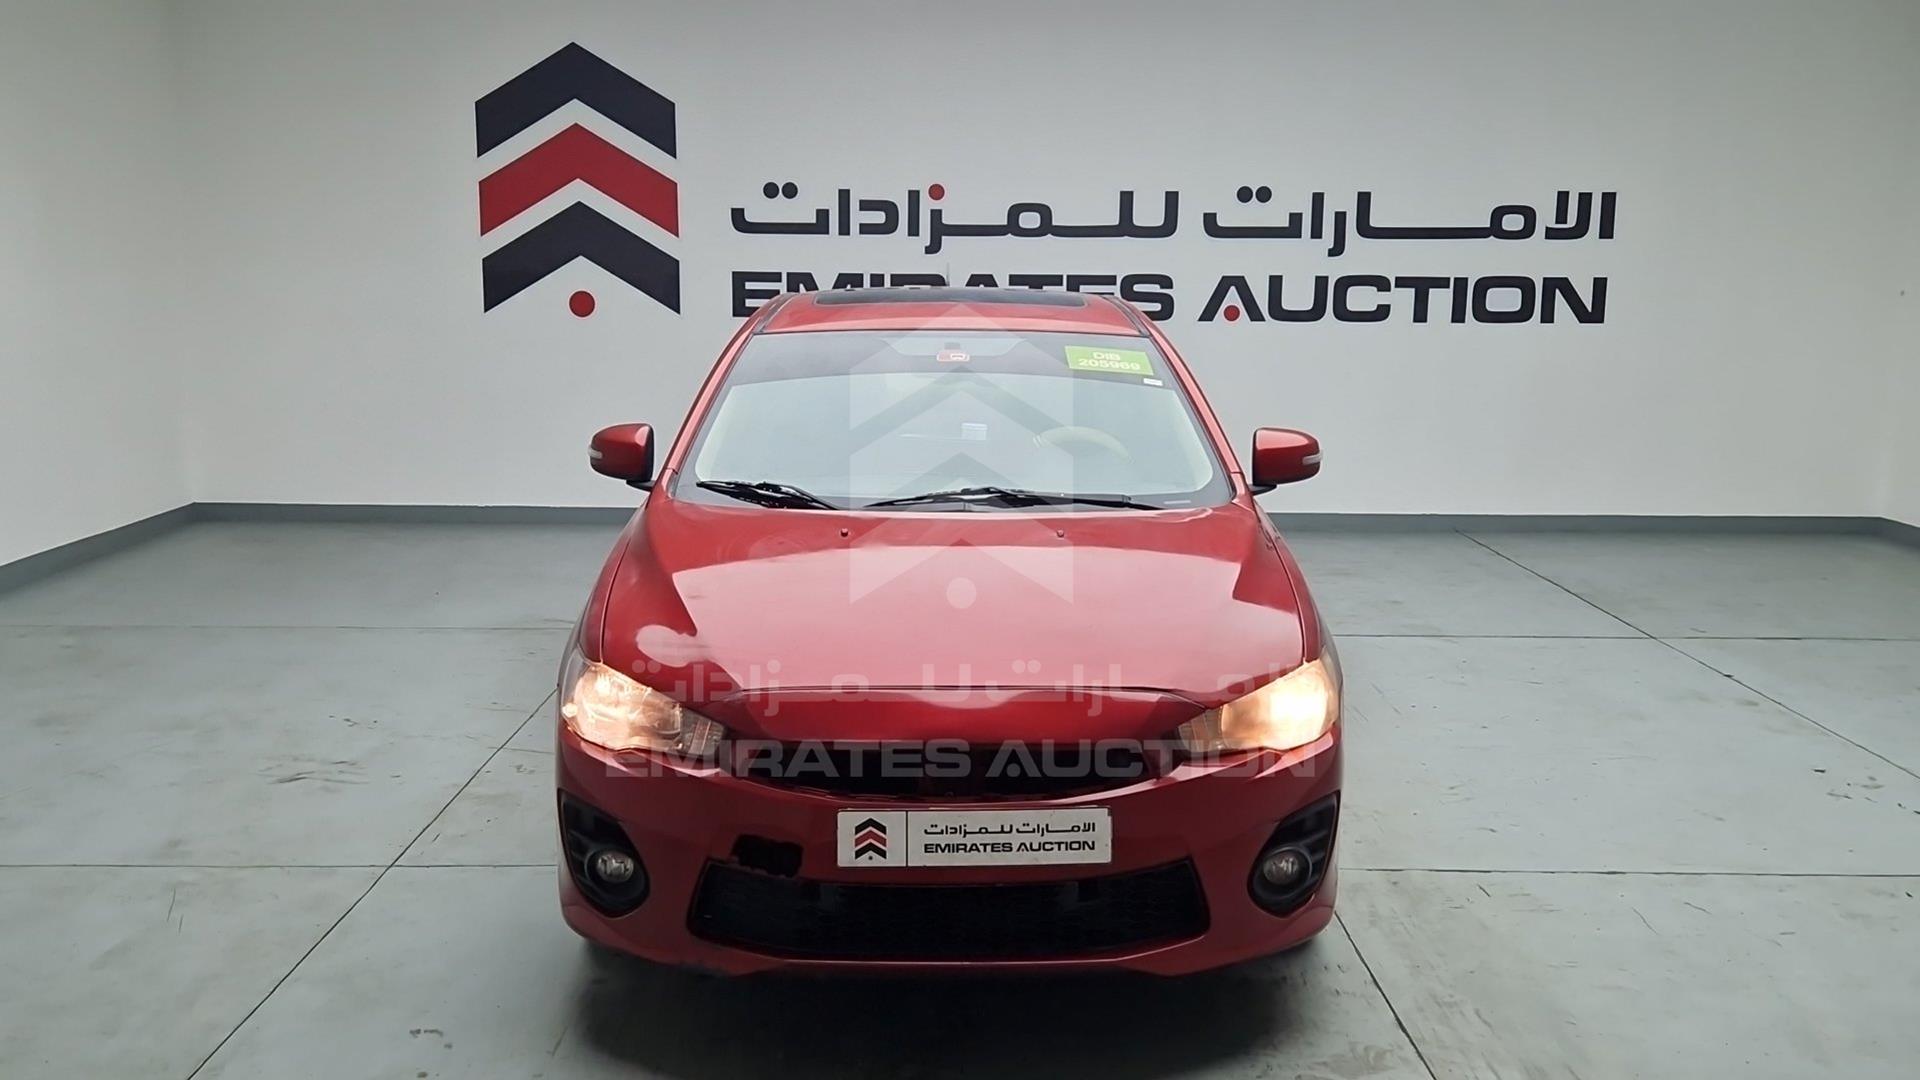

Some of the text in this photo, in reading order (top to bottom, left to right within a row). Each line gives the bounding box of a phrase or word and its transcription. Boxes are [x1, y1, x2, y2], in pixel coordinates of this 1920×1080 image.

[730, 181, 1617, 257] الامارات للمزادات
[1197, 274, 1608, 323] AUCTION
[923, 822, 1096, 838] الامارات للمزادات
[923, 840, 1096, 854] EMIRATES AUCTION
